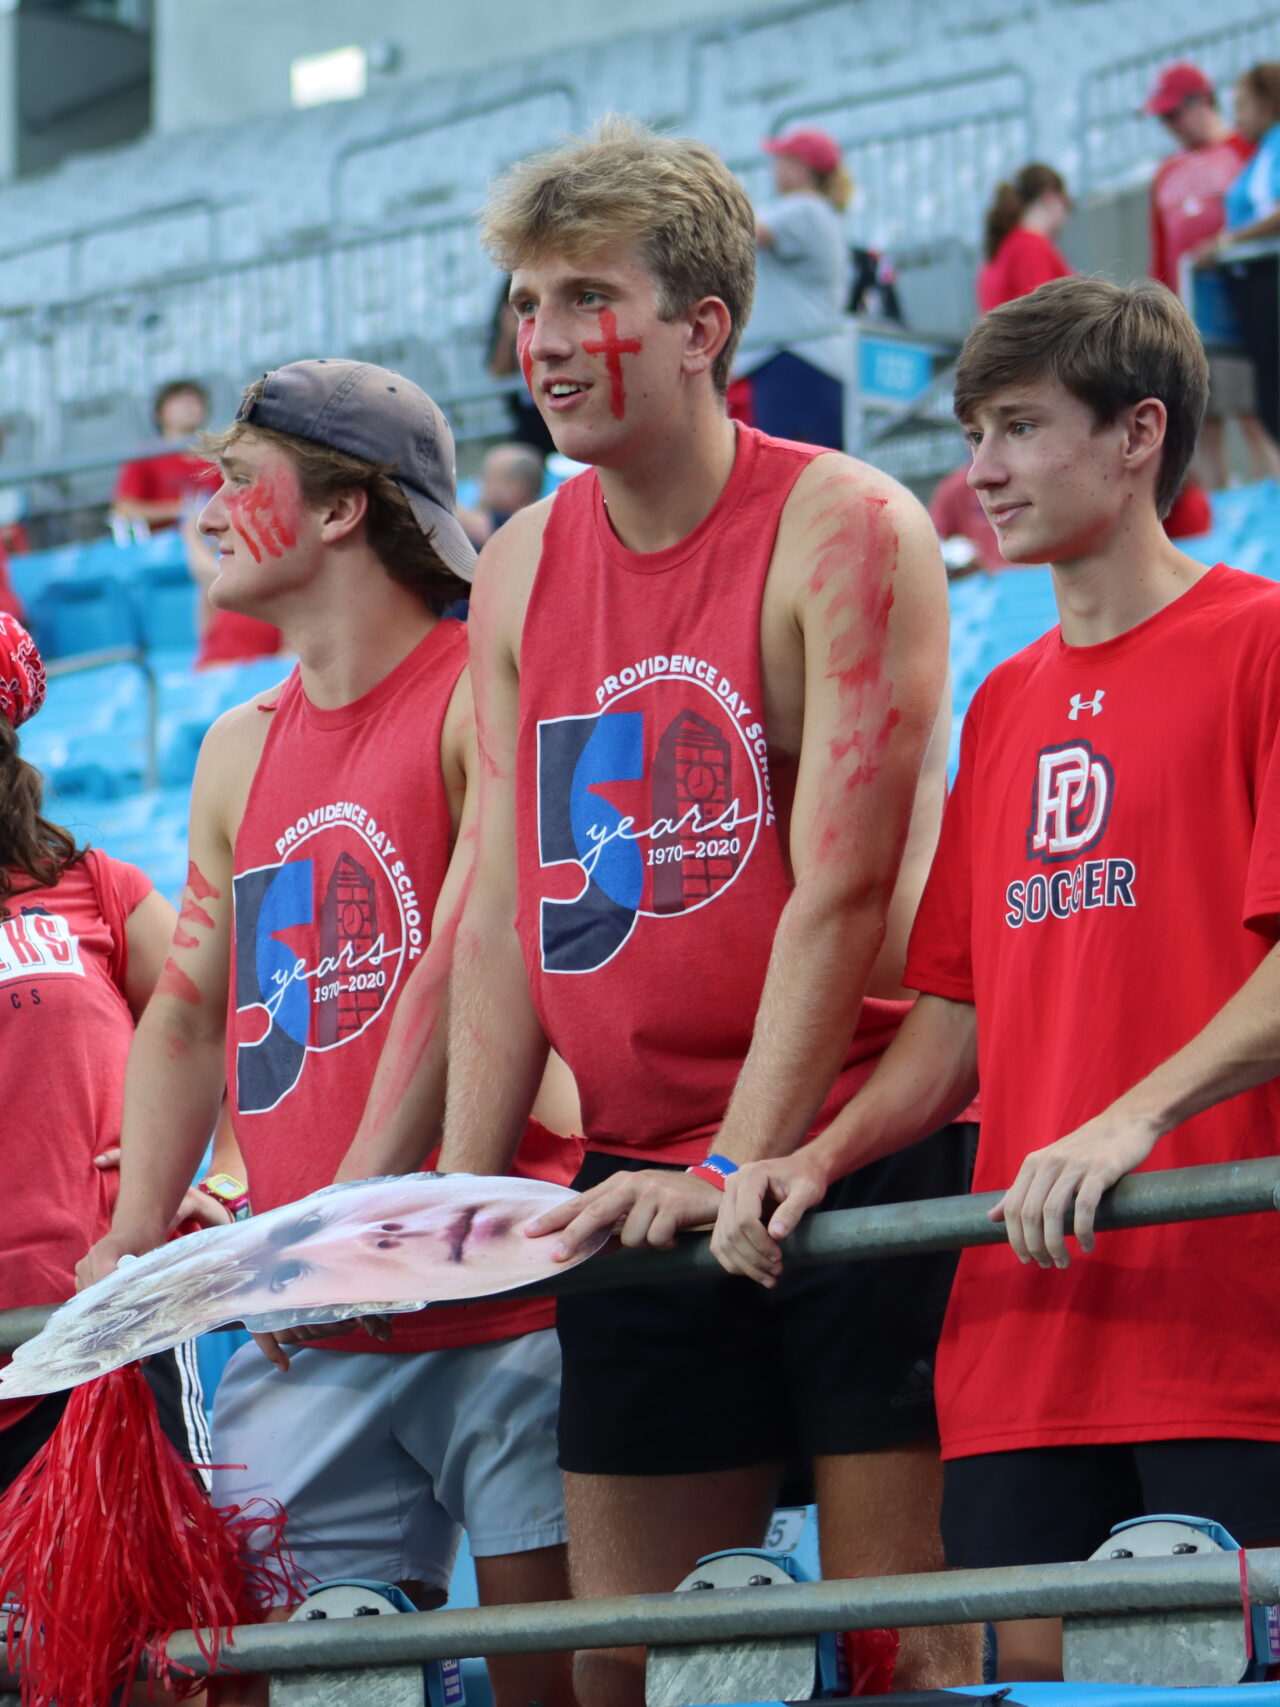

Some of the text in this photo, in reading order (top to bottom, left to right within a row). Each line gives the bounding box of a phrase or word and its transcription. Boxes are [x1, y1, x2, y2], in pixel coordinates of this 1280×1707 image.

[595, 655, 718, 704] PROVIDENCE
[717, 677, 751, 718] DAY
[581, 798, 750, 868] years
[1027, 739, 1114, 864] PD
[275, 802, 422, 960] PROVIDENCE DAY SCHOOL
[1005, 858, 1136, 929] SOCCER
[266, 932, 392, 1012] years
